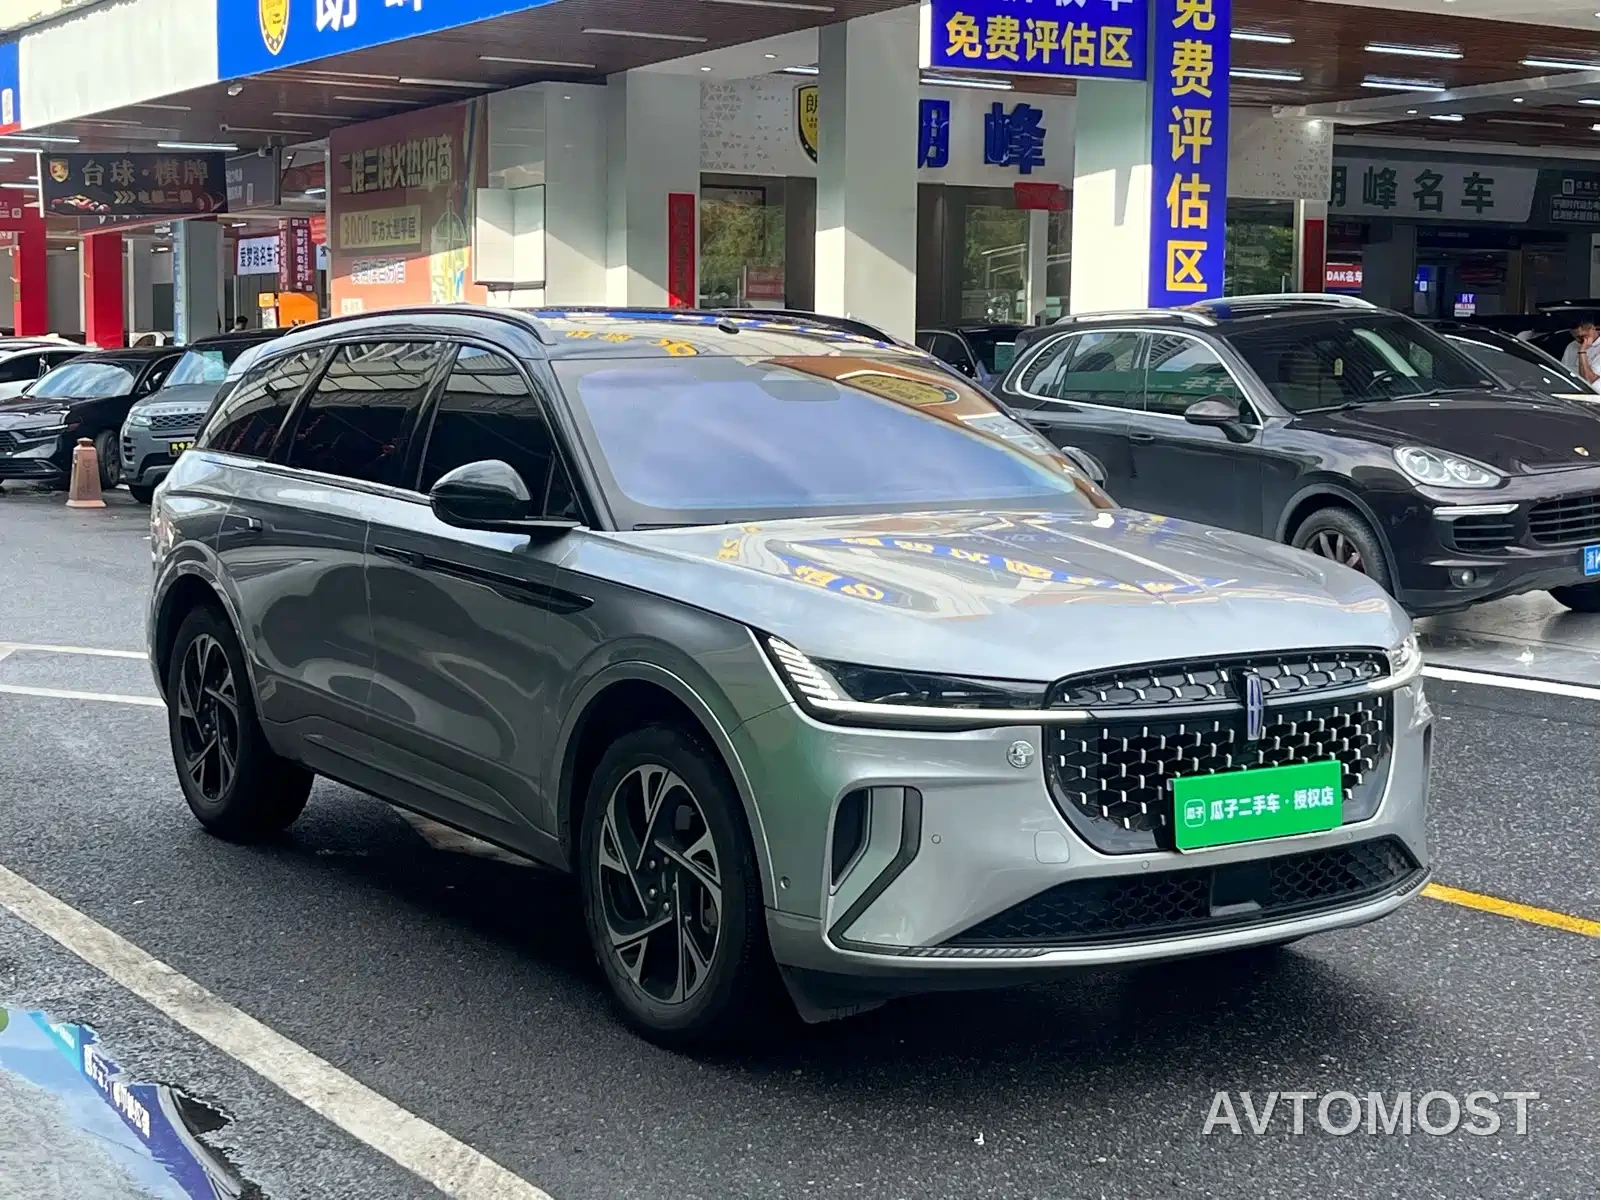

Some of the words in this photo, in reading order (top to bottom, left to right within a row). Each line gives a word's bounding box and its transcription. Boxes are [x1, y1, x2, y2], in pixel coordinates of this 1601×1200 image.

[945, 11, 1133, 68] 免费评估区
